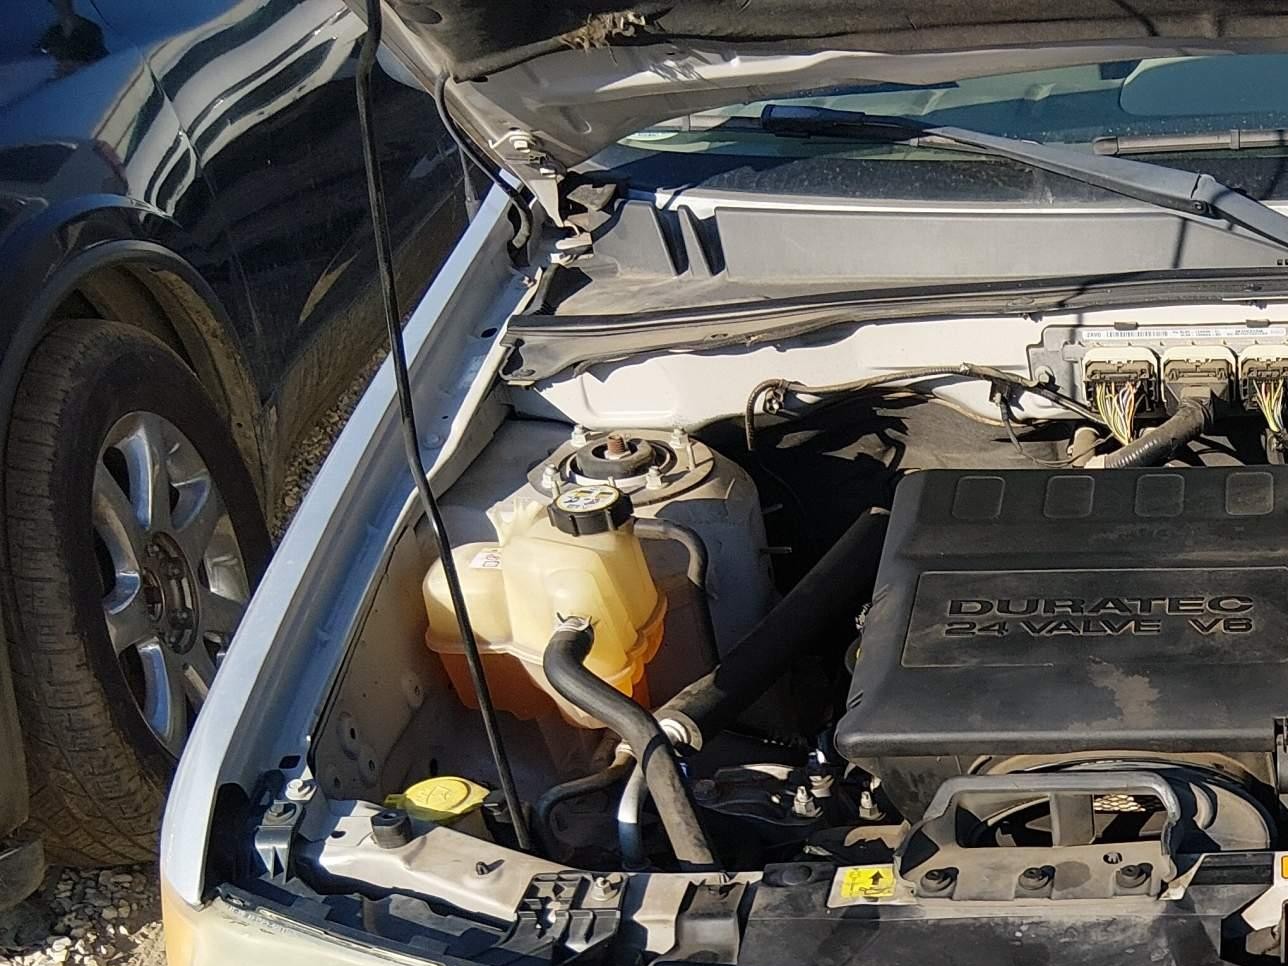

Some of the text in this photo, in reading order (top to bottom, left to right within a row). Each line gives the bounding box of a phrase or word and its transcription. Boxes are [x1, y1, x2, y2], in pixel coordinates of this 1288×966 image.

[948, 596, 1254, 617] DURATEC
[945, 617, 1254, 637] 24 VALVE V6
